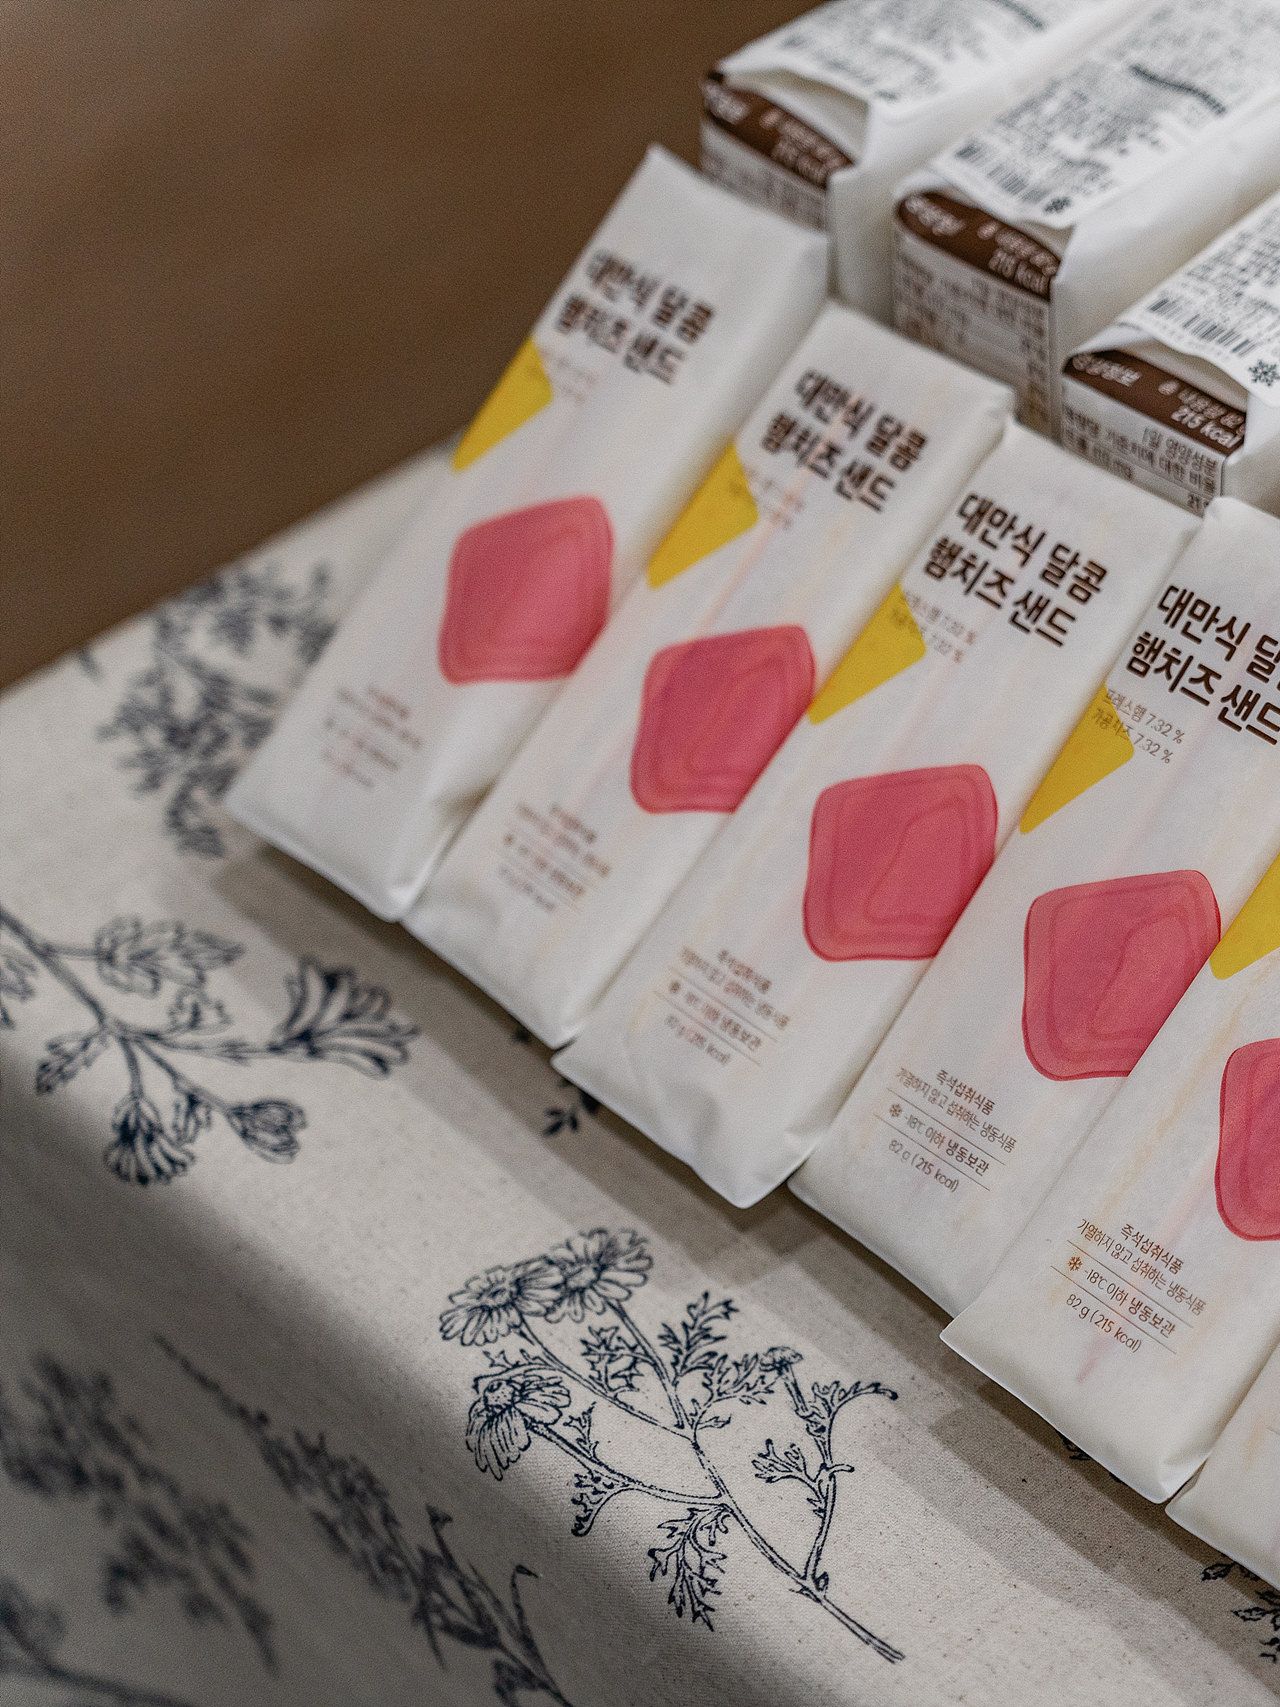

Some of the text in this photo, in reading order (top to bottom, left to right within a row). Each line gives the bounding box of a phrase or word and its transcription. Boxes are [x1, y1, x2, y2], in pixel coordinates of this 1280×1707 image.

[794, 368, 929, 473] 대만식 달콤
[759, 412, 897, 514] 햄치즈 샌드
[956, 493, 1108, 606] 대만식 달콤
[922, 535, 1076, 648] 햄치즈 샌드
[1157, 583, 1251, 661] 대만식
[1126, 630, 1222, 708] 햄치즈
[1133, 731, 1160, 756] 7.32
[1146, 712, 1174, 737] 7.32
[935, 1068, 995, 1116] 즉석섭취식품
[924, 1126, 990, 1176] 이하 냉동보관
[934, 1168, 960, 1193] kcal)
[1077, 1219, 1206, 1316] 가열하지 않고 섭취하는 냉동식품
[1120, 1223, 1184, 1275] 즉석섭취식품
[1066, 1293, 1082, 1309] 82
[1090, 1310, 1115, 1333] (215
[1113, 1322, 1143, 1353] kcal)
[1106, 1281, 1128, 1306] 이하
[1128, 1294, 1177, 1338] 냉동보관
